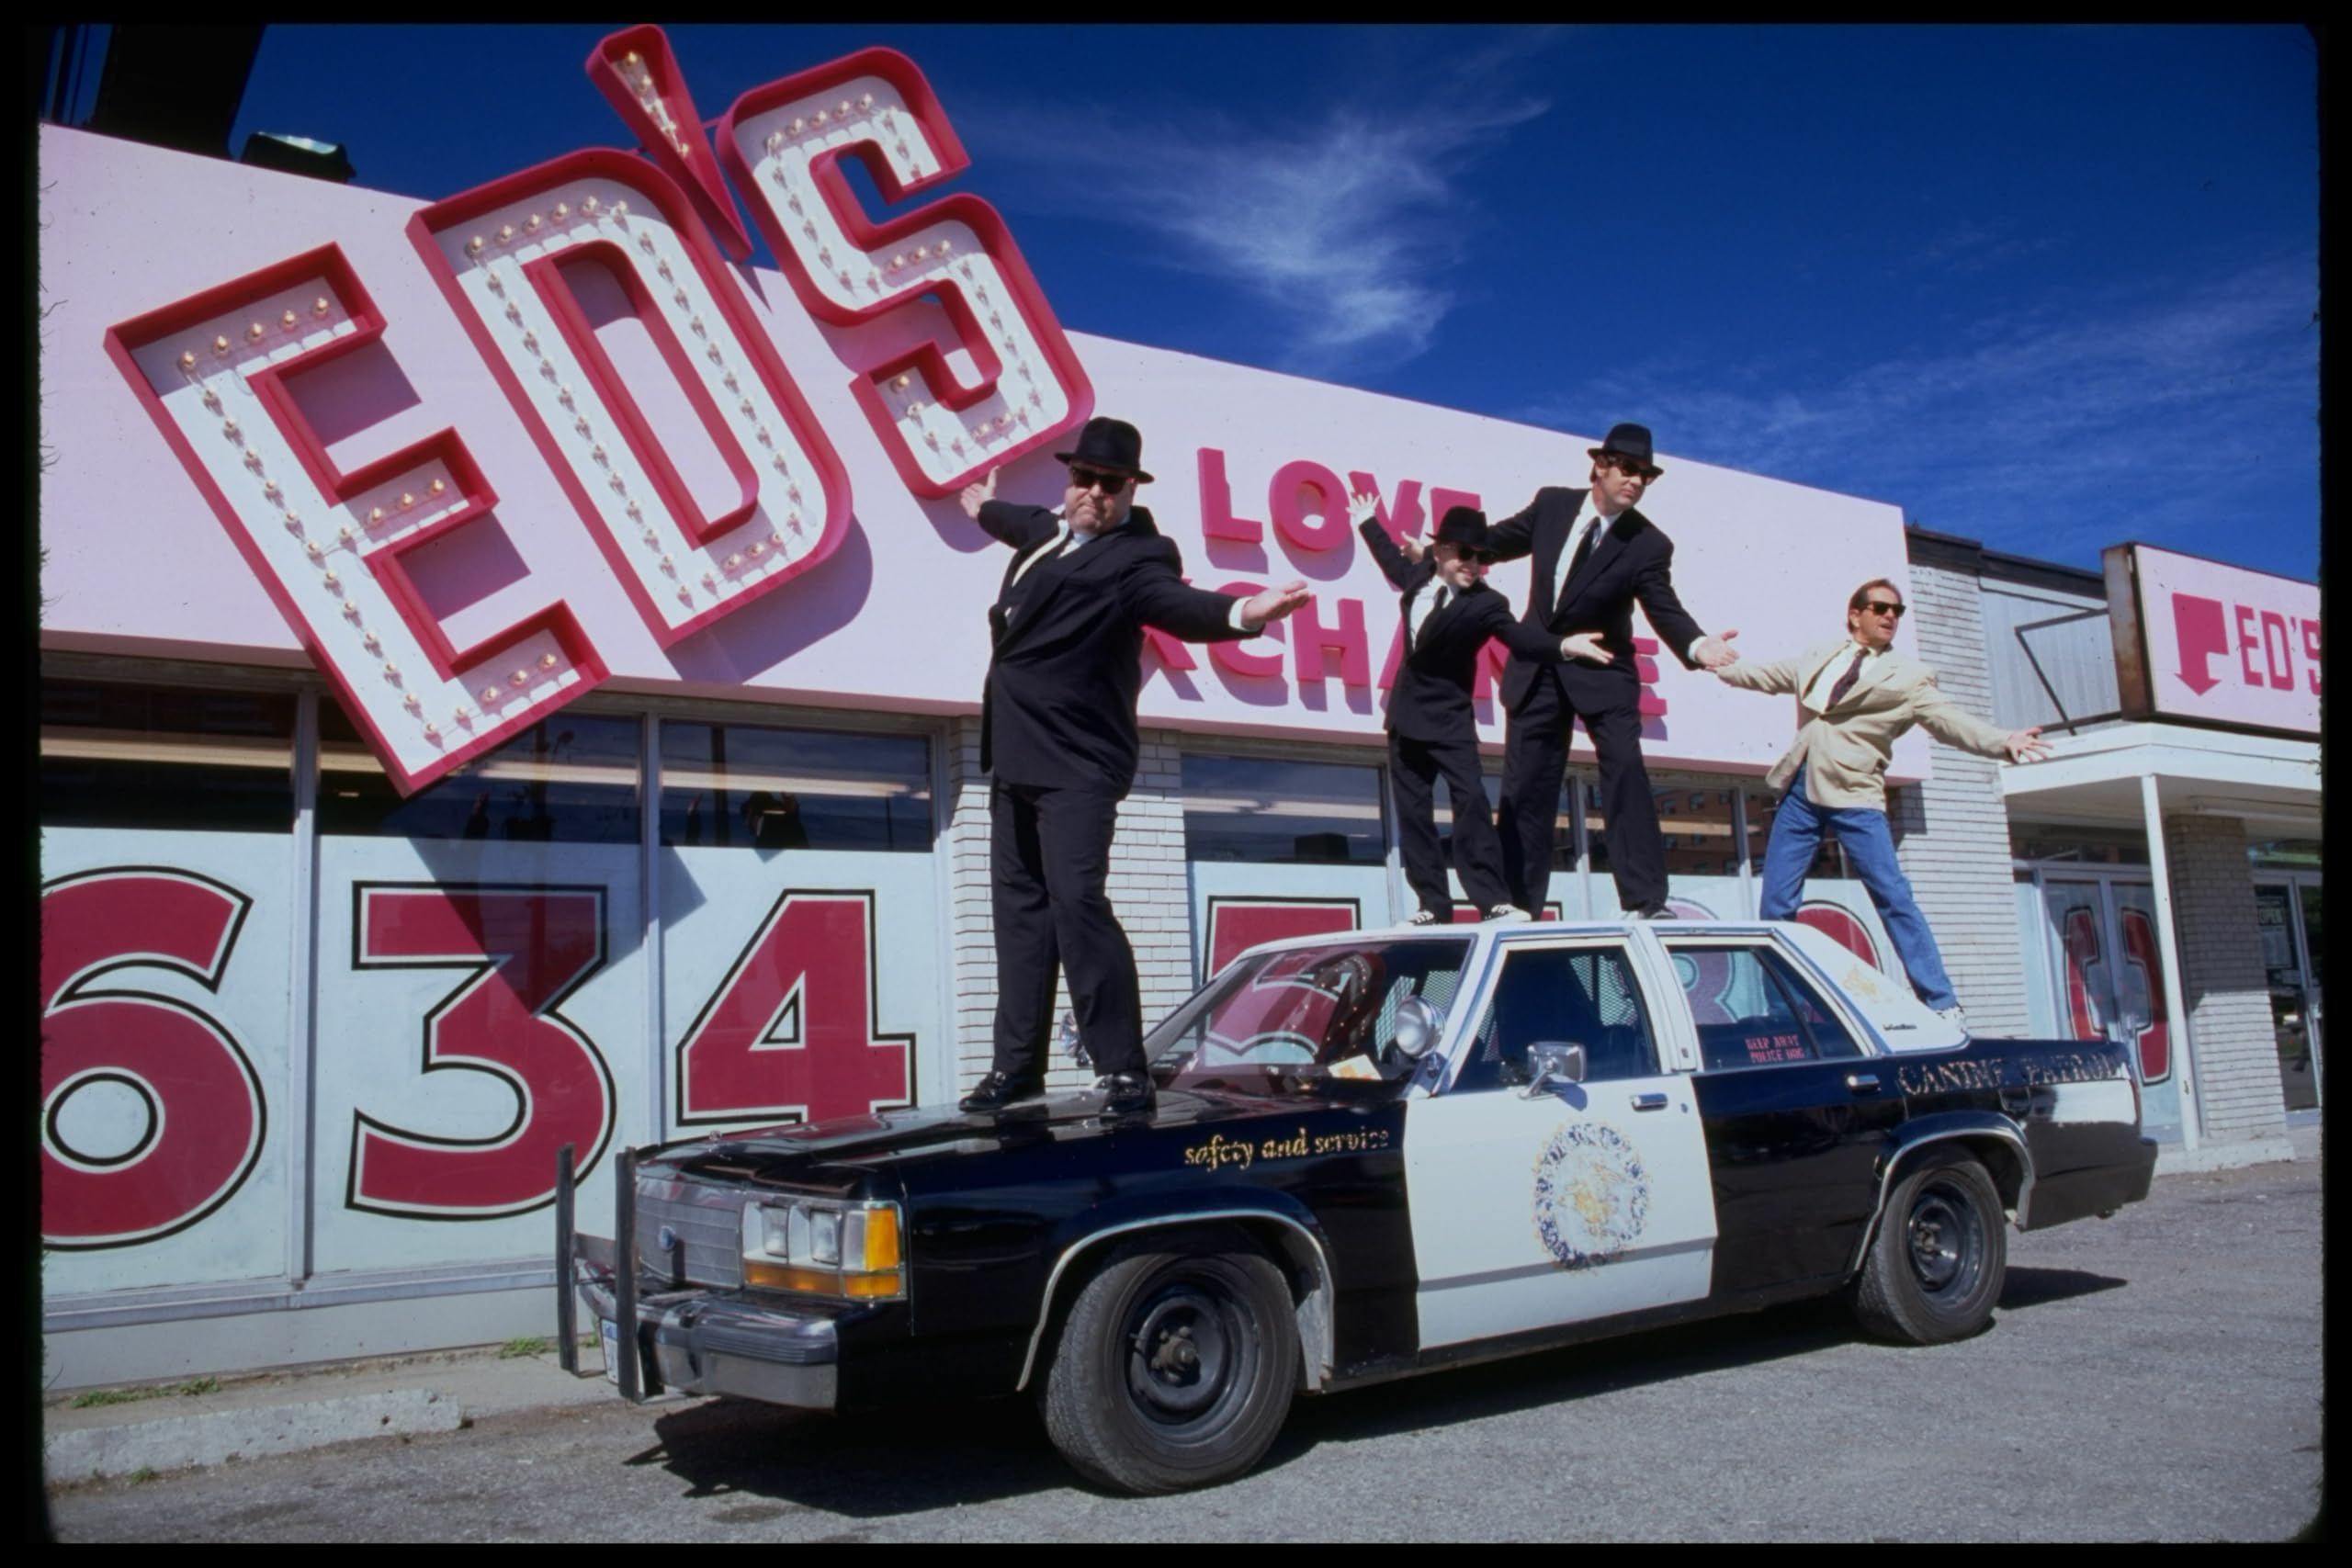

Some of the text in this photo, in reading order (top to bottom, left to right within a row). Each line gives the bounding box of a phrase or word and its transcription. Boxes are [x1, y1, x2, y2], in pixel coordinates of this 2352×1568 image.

[104, 23, 1094, 797] ED'S
[2234, 604, 2321, 696] ED'S
[1184, 1125, 1389, 1172] safety and service
